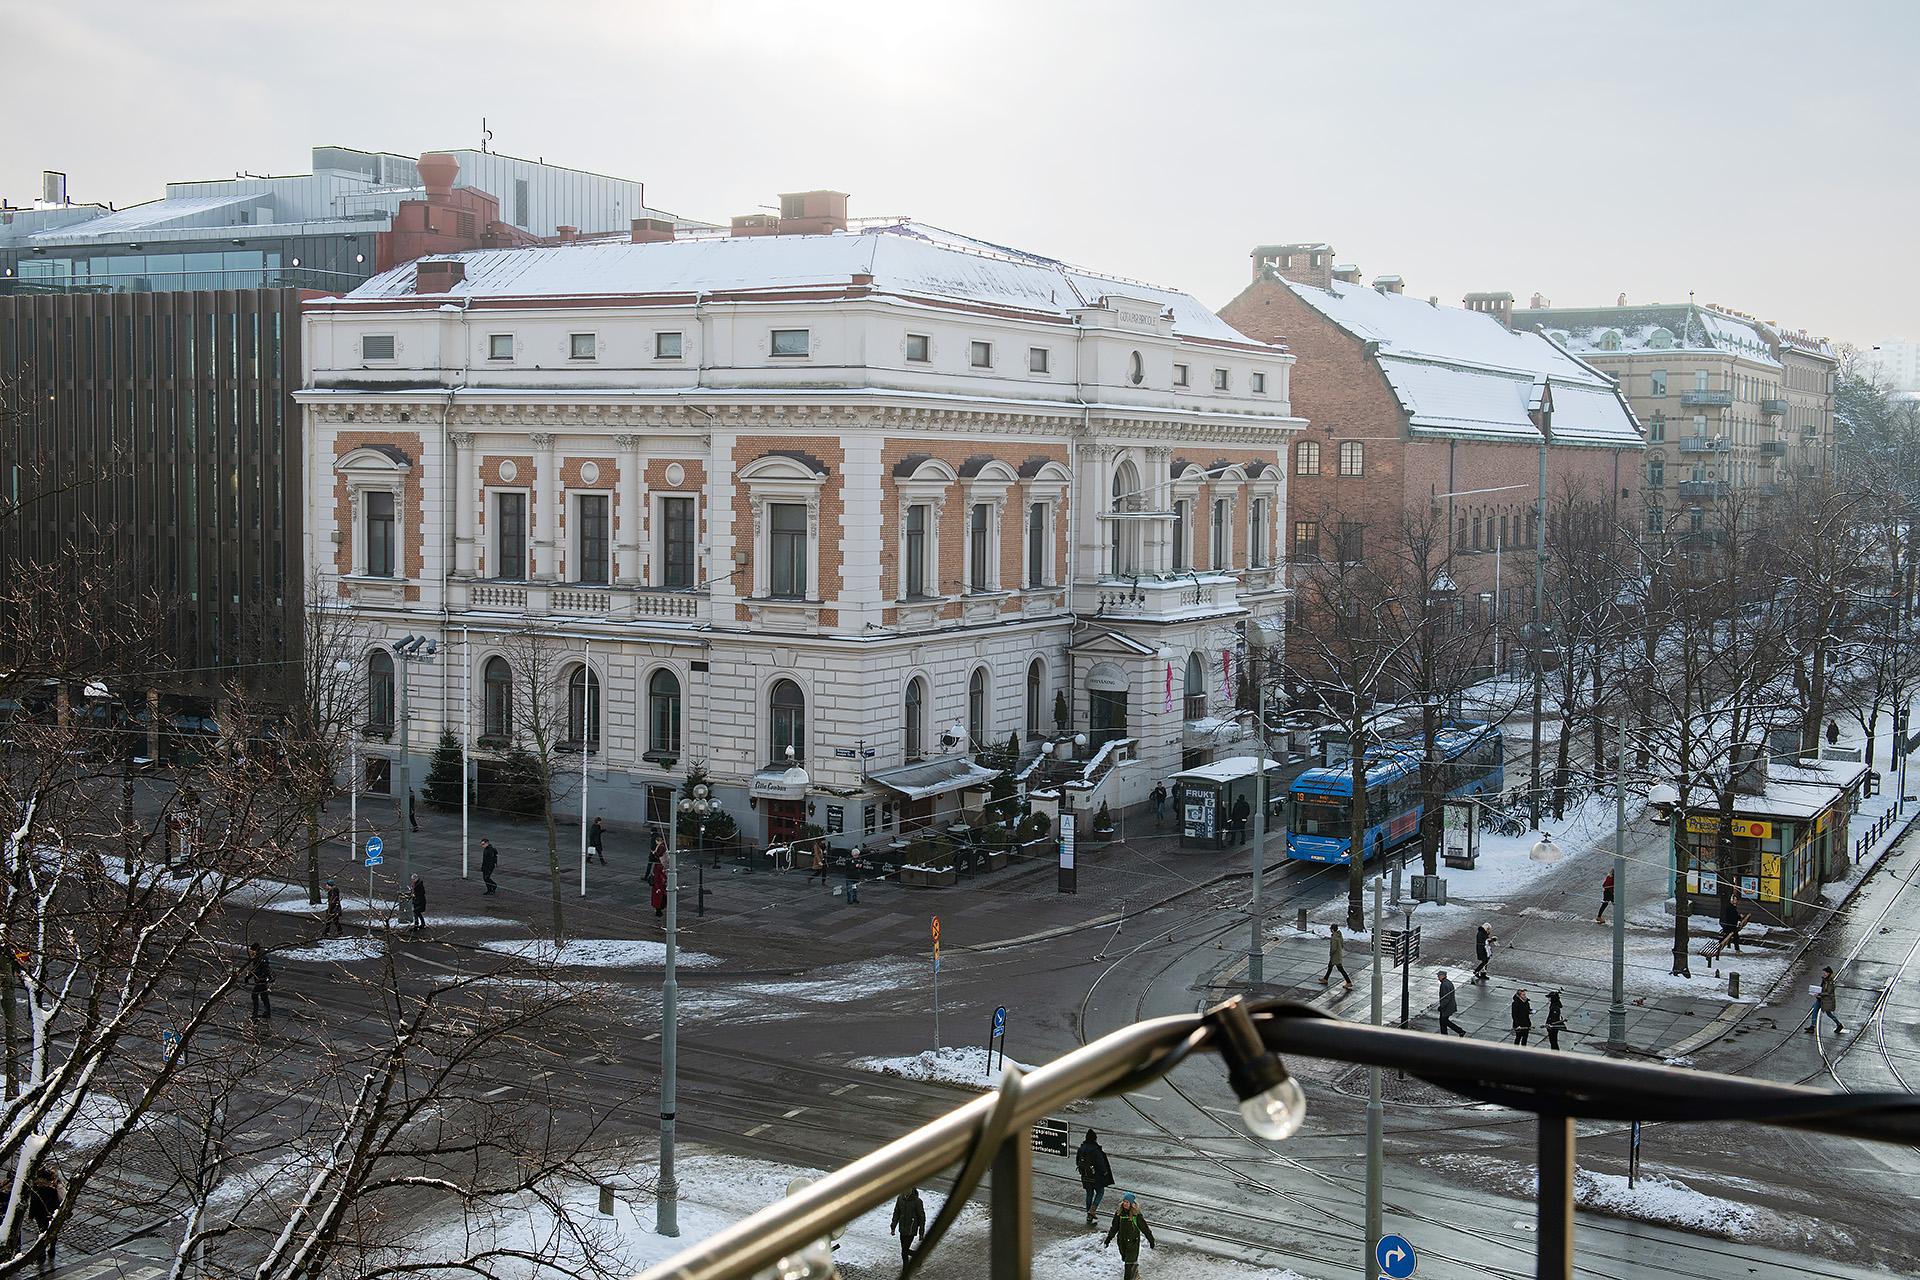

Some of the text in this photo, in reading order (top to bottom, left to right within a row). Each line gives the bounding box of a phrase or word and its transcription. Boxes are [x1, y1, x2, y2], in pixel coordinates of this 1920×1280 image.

[1185, 789, 1215, 798] FRUKT
[1064, 816, 1071, 827] A
[1689, 818, 1746, 833] Pressån
[1031, 1145, 1061, 1154] portsplatsen
